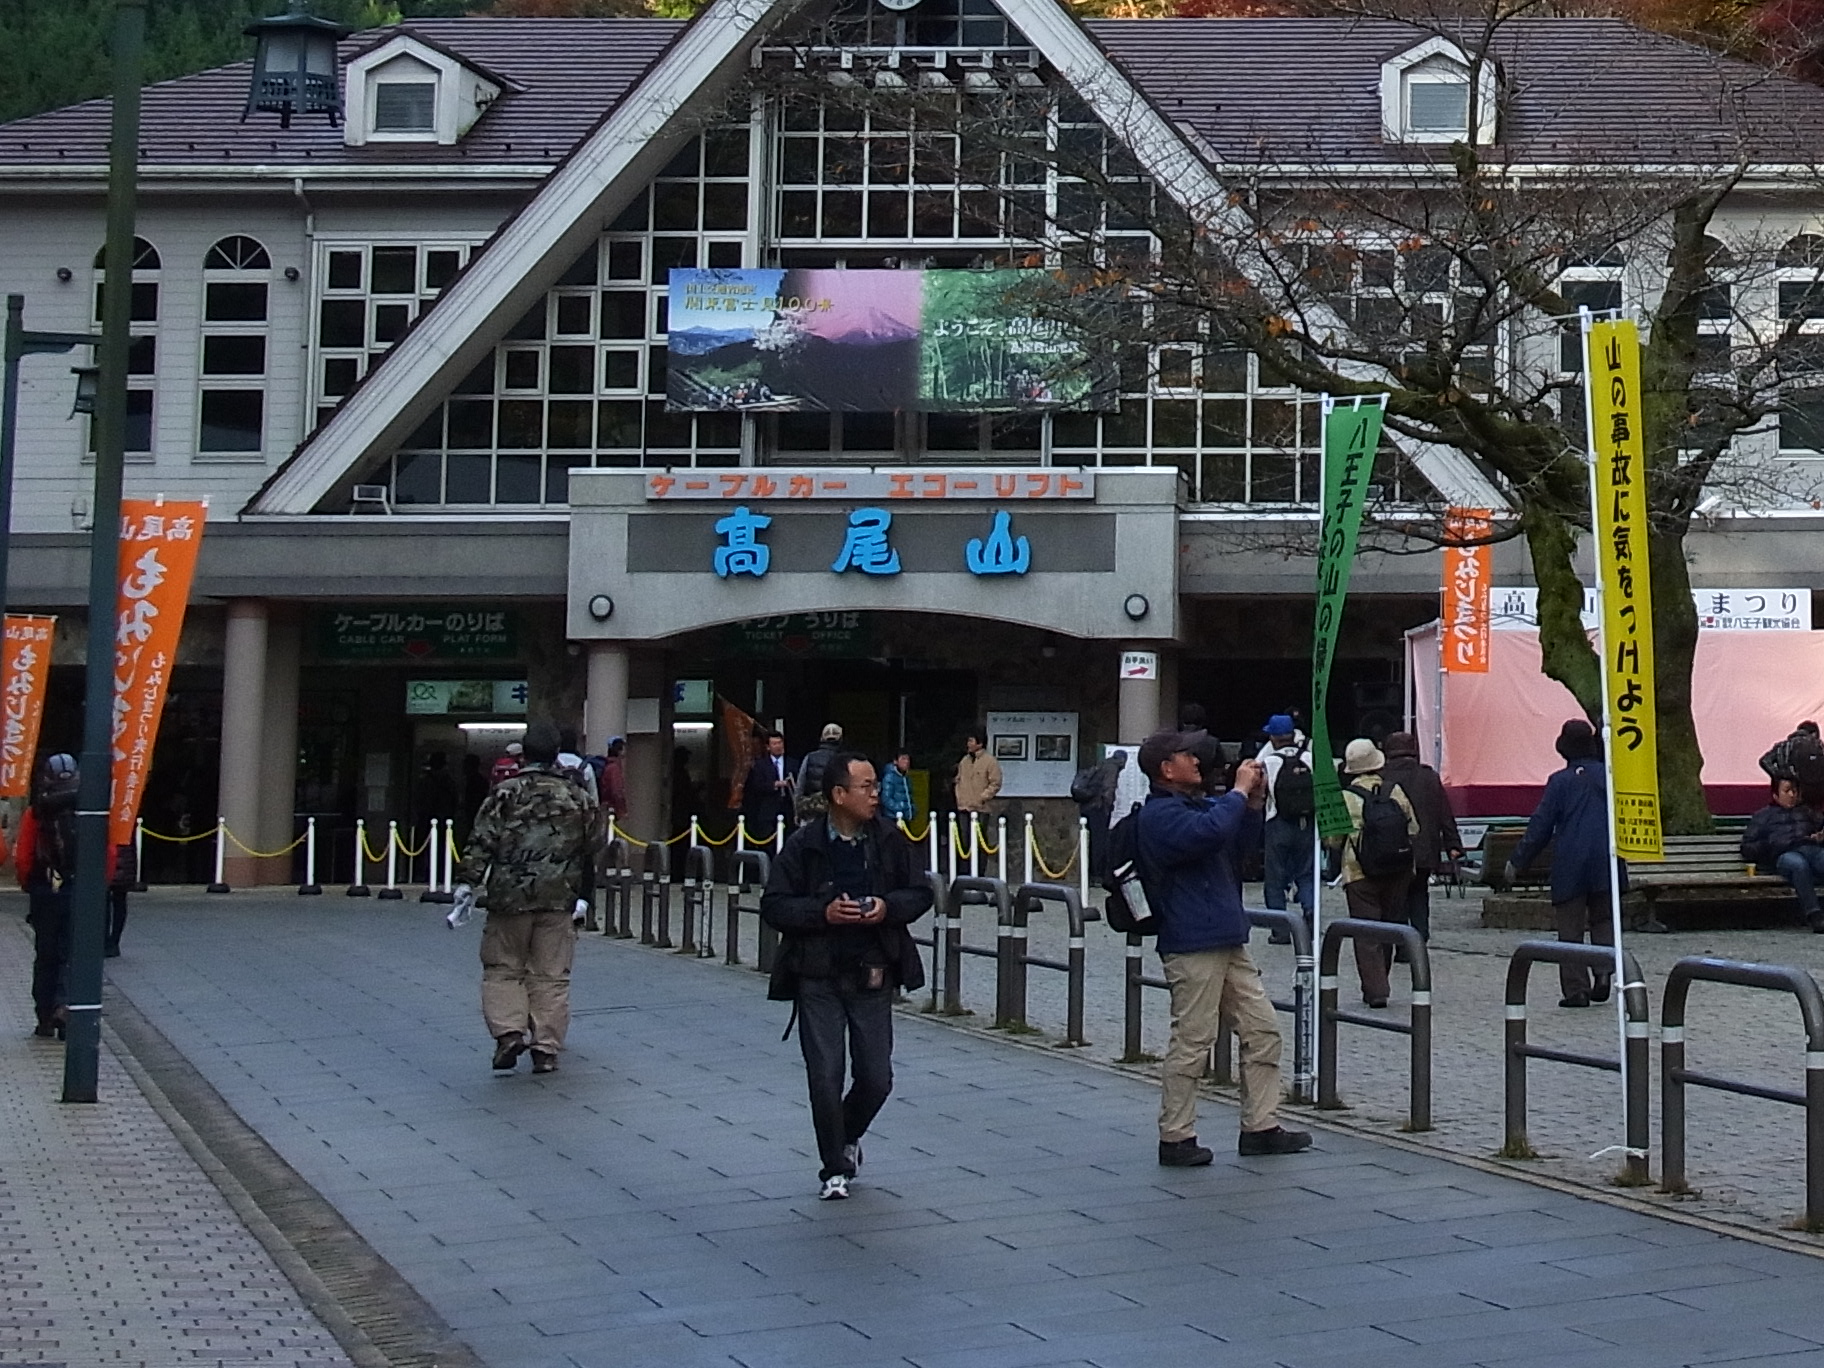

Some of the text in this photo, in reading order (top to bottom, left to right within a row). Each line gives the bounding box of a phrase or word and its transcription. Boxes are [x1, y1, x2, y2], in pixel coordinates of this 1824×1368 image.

[650, 474, 847, 498] ケーブルカー
[1606, 336, 1643, 751] 山の事故に気をつけよう
[339, 634, 507, 644] CABLE CAR PLAT FORM
[745, 631, 851, 640] TICKET OFFICE
